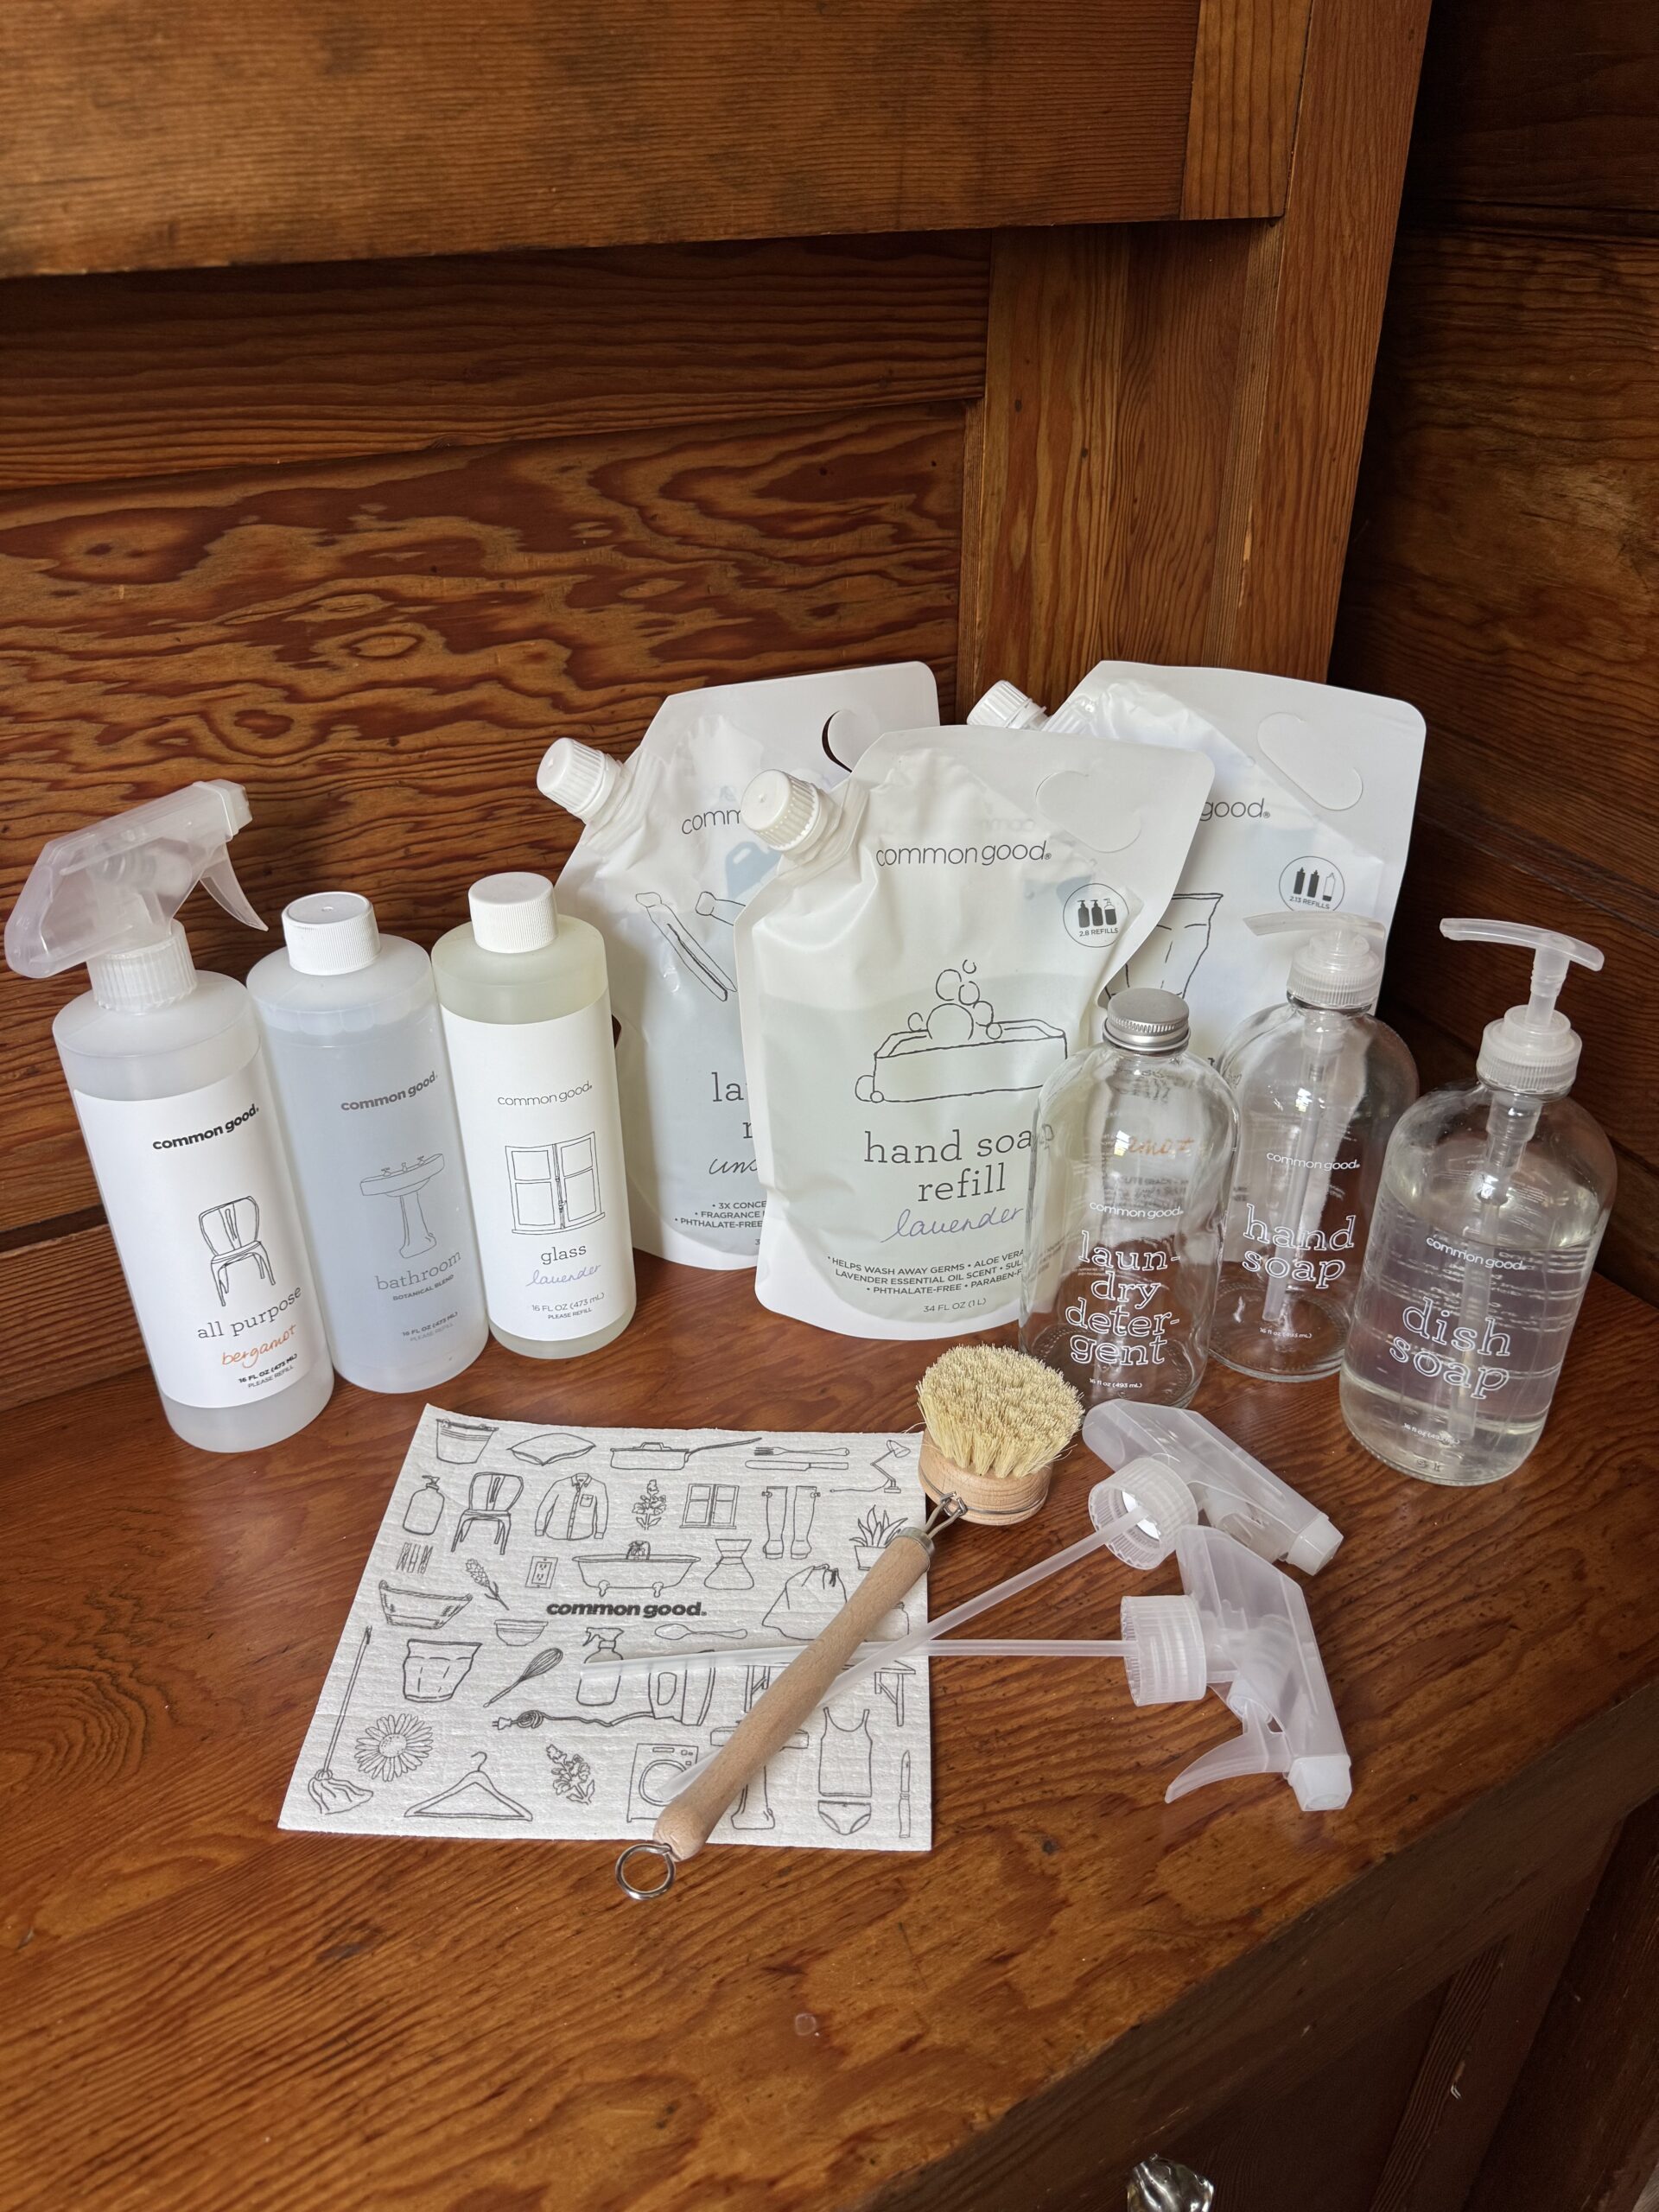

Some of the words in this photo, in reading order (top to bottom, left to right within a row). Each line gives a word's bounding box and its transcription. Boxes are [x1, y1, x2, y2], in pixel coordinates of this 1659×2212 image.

[682, 810, 741, 835] comm
[875, 843, 977, 867] common
[1303, 899, 1330, 910] REFILLS
[340, 1090, 407, 1111] common
[497, 1094, 557, 1106] common
[152, 1126, 224, 1150] common
[864, 1128, 963, 1164] hand
[1266, 1152, 1321, 1169] common
[917, 1162, 1007, 1203] refill
[701, 1211, 760, 1219] FRAGRANCE
[1090, 1202, 1145, 1217] common
[680, 1217, 763, 1229] PHTHALATE-FREE
[880, 1206, 1025, 1243] lavender
[1243, 1203, 1357, 1251] hand
[541, 1245, 587, 1265] glass
[1077, 1230, 1181, 1274] laun-
[1426, 1237, 1484, 1264] common
[374, 1251, 461, 1290] bathroom
[525, 1265, 601, 1287] lavender
[832, 1257, 861, 1272] HELPS
[864, 1265, 895, 1275] WASH
[898, 1267, 928, 1275] AWAY
[930, 1263, 965, 1274] GERMS
[973, 1255, 1000, 1268] ALOE
[836, 1268, 888, 1285] LAVENDER
[890, 1276, 944, 1285] ESSENTIAL
[947, 1273, 964, 1281] OIL
[966, 1267, 997, 1280] SCENT
[1242, 1249, 1345, 1289] soap
[392, 1286, 434, 1301] BOTANICAL
[435, 1274, 454, 1288] BLEND
[873, 1284, 962, 1294] PHTHALATE-FREE
[970, 1268, 1022, 1288] PARABEN-F
[1090, 1270, 1161, 1310] dry
[197, 1321, 224, 1338] all
[230, 1287, 302, 1337] purpose
[572, 1307, 593, 1316] REFILL
[923, 1305, 935, 1313] 34
[938, 1303, 950, 1312] FL
[952, 1301, 966, 1310] OZ
[1065, 1297, 1180, 1338] deter-
[1402, 1296, 1511, 1357] dish
[221, 1324, 296, 1369] bergamot
[1070, 1333, 1168, 1366] gent
[259, 1369, 270, 1377] OZ
[1389, 1337, 1510, 1400] soap
[248, 1374, 274, 1388] PLEASE
[546, 1603, 640, 1616] common
